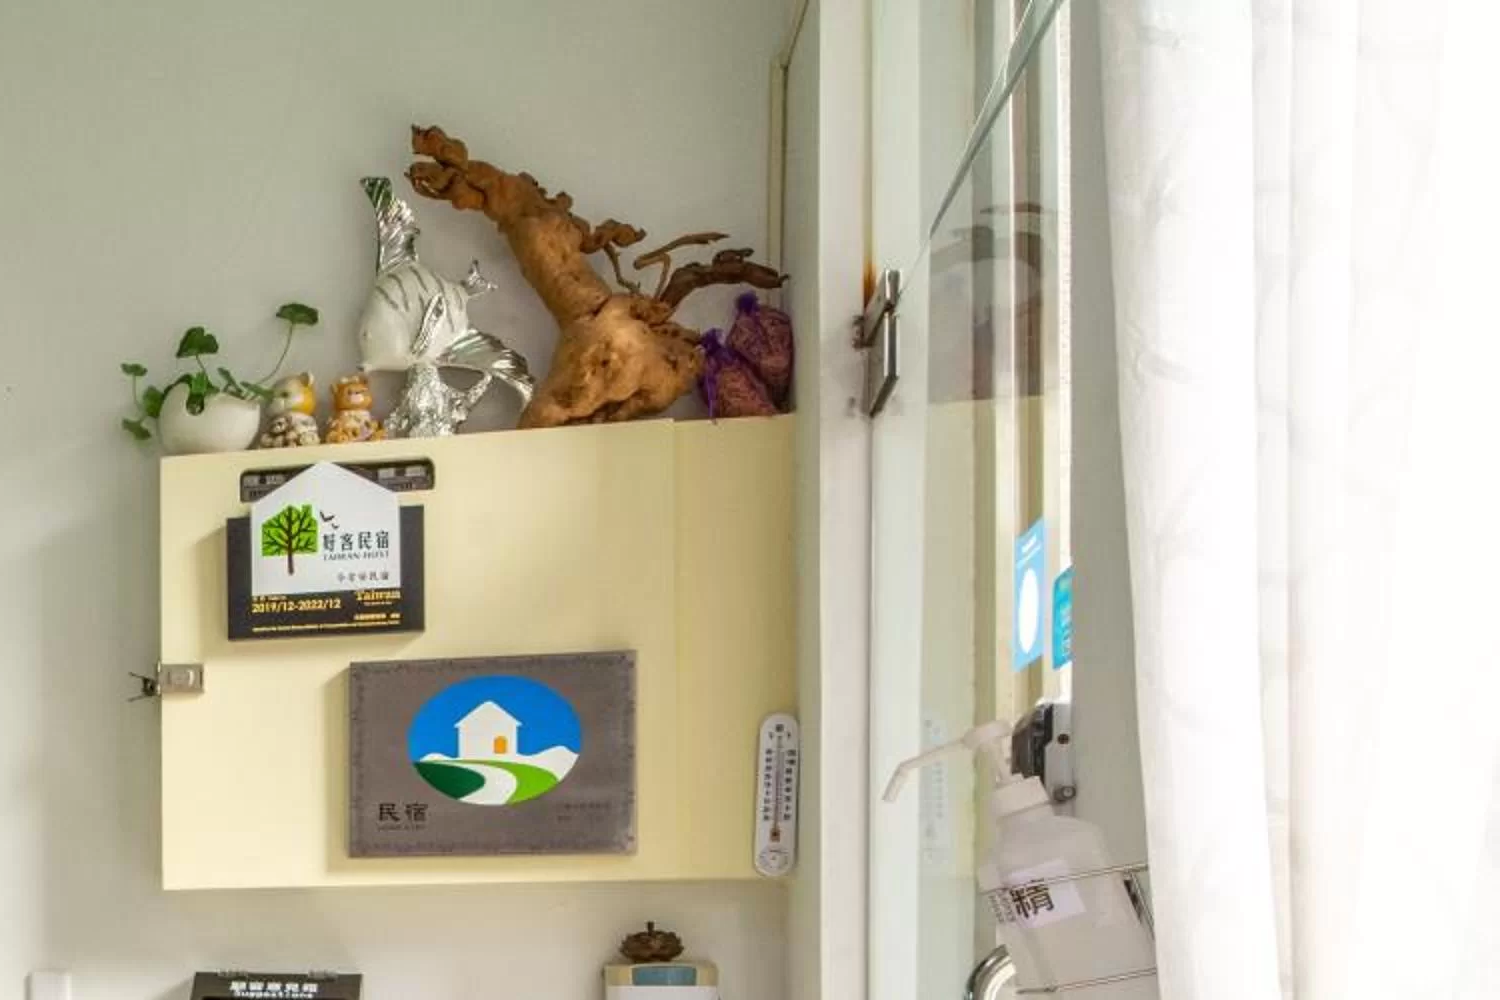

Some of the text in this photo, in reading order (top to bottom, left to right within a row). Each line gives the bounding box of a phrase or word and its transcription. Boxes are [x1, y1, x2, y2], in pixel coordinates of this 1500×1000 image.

[323, 530, 389, 552] 好客民宿
[379, 801, 428, 821] 民宿
